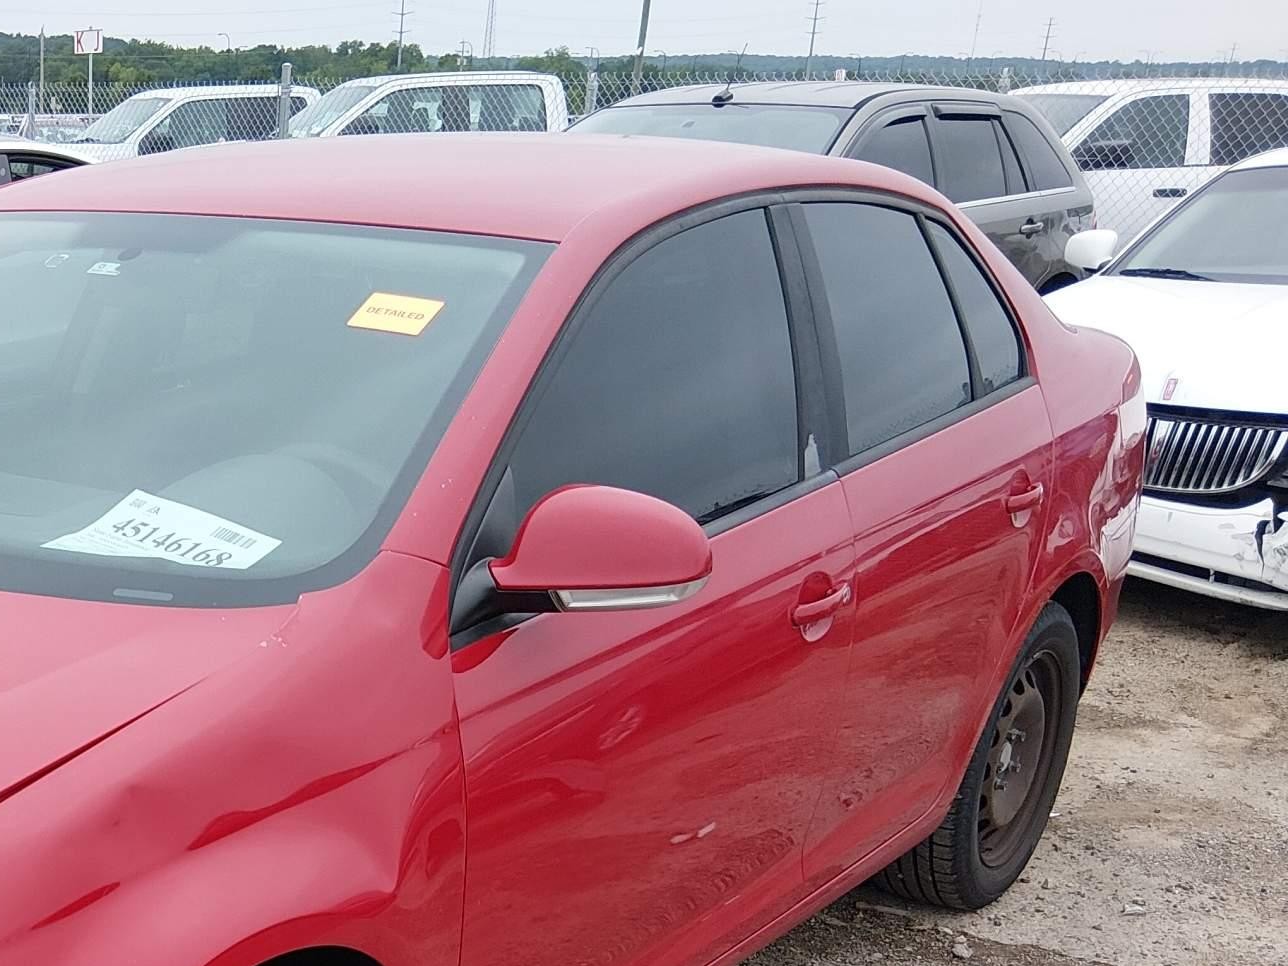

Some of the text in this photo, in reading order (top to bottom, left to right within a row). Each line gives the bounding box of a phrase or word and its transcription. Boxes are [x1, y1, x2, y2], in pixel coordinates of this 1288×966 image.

[76, 31, 100, 53] K J
[366, 305, 425, 321] DETAILED
[112, 517, 233, 568] 45146168
